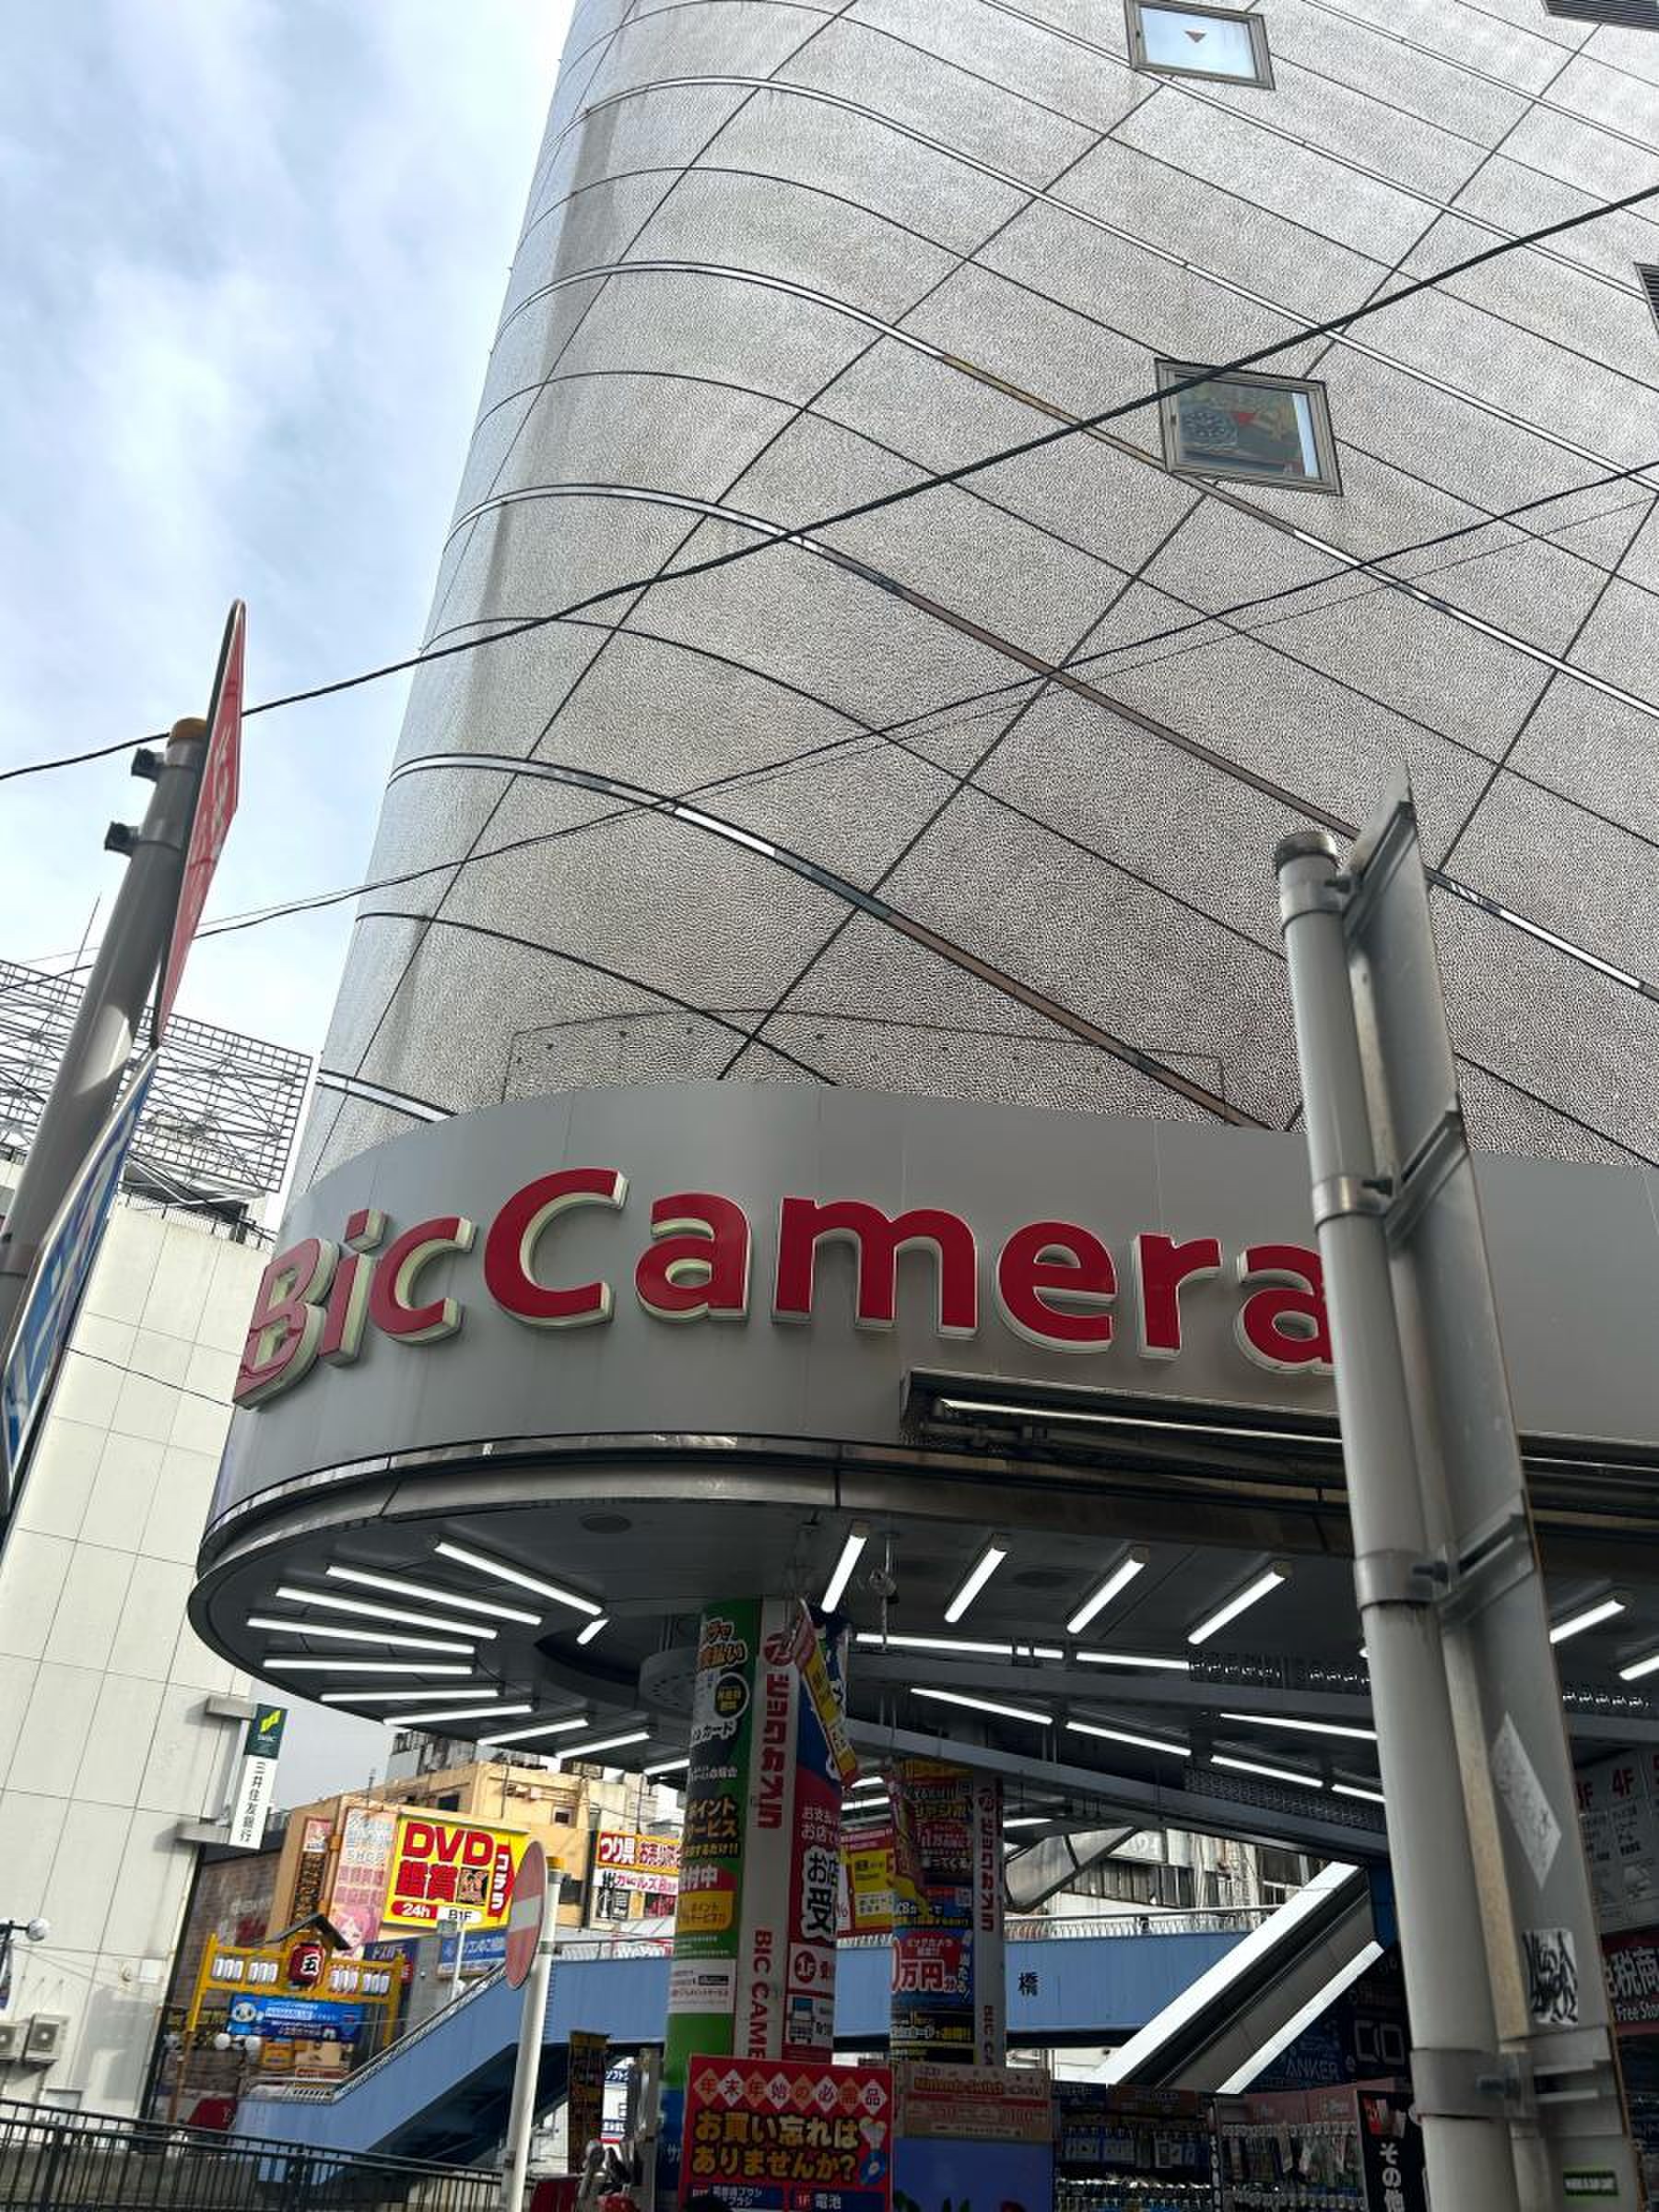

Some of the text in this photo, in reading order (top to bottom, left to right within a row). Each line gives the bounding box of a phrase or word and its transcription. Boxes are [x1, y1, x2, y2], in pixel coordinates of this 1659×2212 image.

[233, 1168, 1334, 1408] BicCamera
[1613, 1768, 1634, 1797] 4F
[240, 1761, 266, 1843] 三井住友銀行
[402, 1821, 495, 1866] DVD
[394, 1860, 460, 1903] 鑑賞
[400, 1902, 431, 1919] 24h
[753, 1930, 773, 1974] BIC
[1018, 1971, 1040, 1997] 橋
[1285, 2058, 1339, 2080] ANKER
[700, 2077, 881, 2107] 年末年始の必需品
[694, 2109, 860, 2150] お買い忘れは
[692, 2146, 857, 2182] ありませんか?
[814, 2192, 841, 2210] 電池
